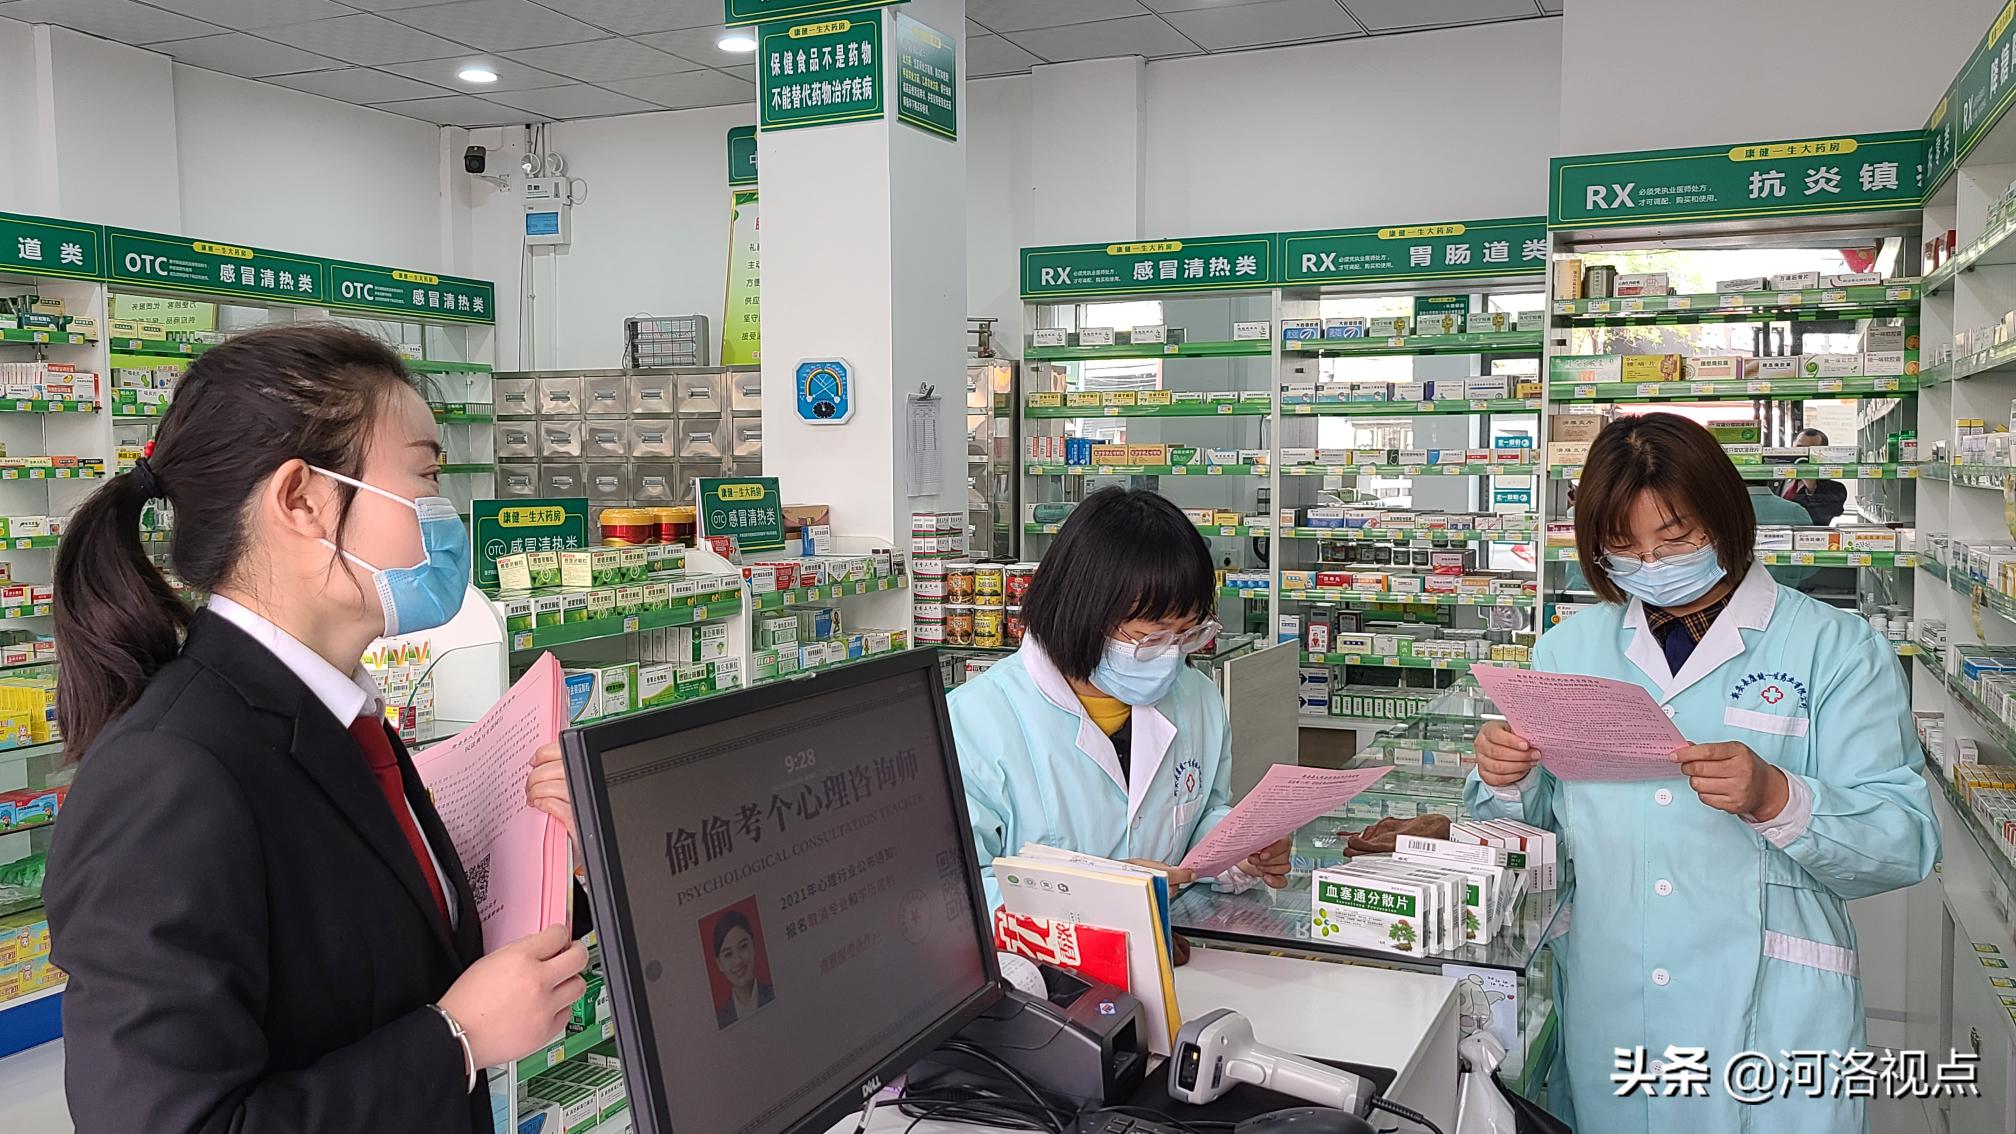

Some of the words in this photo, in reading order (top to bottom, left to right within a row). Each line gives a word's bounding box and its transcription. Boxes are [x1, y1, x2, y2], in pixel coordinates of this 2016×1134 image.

[793, 22, 846, 37] 康健一生大药房
[770, 40, 873, 76] 保健食品不是药物
[771, 75, 873, 111] 不能替代药物治疗疾病
[1744, 142, 1840, 158] 康健一生大药房
[1748, 161, 1922, 199] 抗炎镇
[1585, 183, 1636, 210] RX
[17, 236, 84, 266] 道类
[125, 252, 169, 276] OTC
[1302, 252, 1337, 274] RX
[1410, 238, 1547, 269] 胃肠道类
[219, 263, 314, 293] 感冒清热类
[1041, 266, 1073, 287] RX
[1133, 255, 1248, 282] 感冒清热类
[341, 281, 375, 301] OTC
[412, 288, 485, 314] 感冒清热类
[720, 486, 762, 498] 康健一生大药房
[502, 510, 562, 524] 康健一生大药房
[714, 514, 725, 524] OTC
[728, 507, 777, 528] 感冒清热类
[487, 544, 505, 557] OTC
[784, 747, 817, 774] 9:28
[665, 746, 921, 877] 偷偷考个心理咨询师
[677, 848, 791, 907] PSYCHOLOGICAL
[793, 809, 880, 857] CONSULTATION
[1325, 884, 1409, 911] 血塞通分散片
[862, 1075, 882, 1098] DELL
